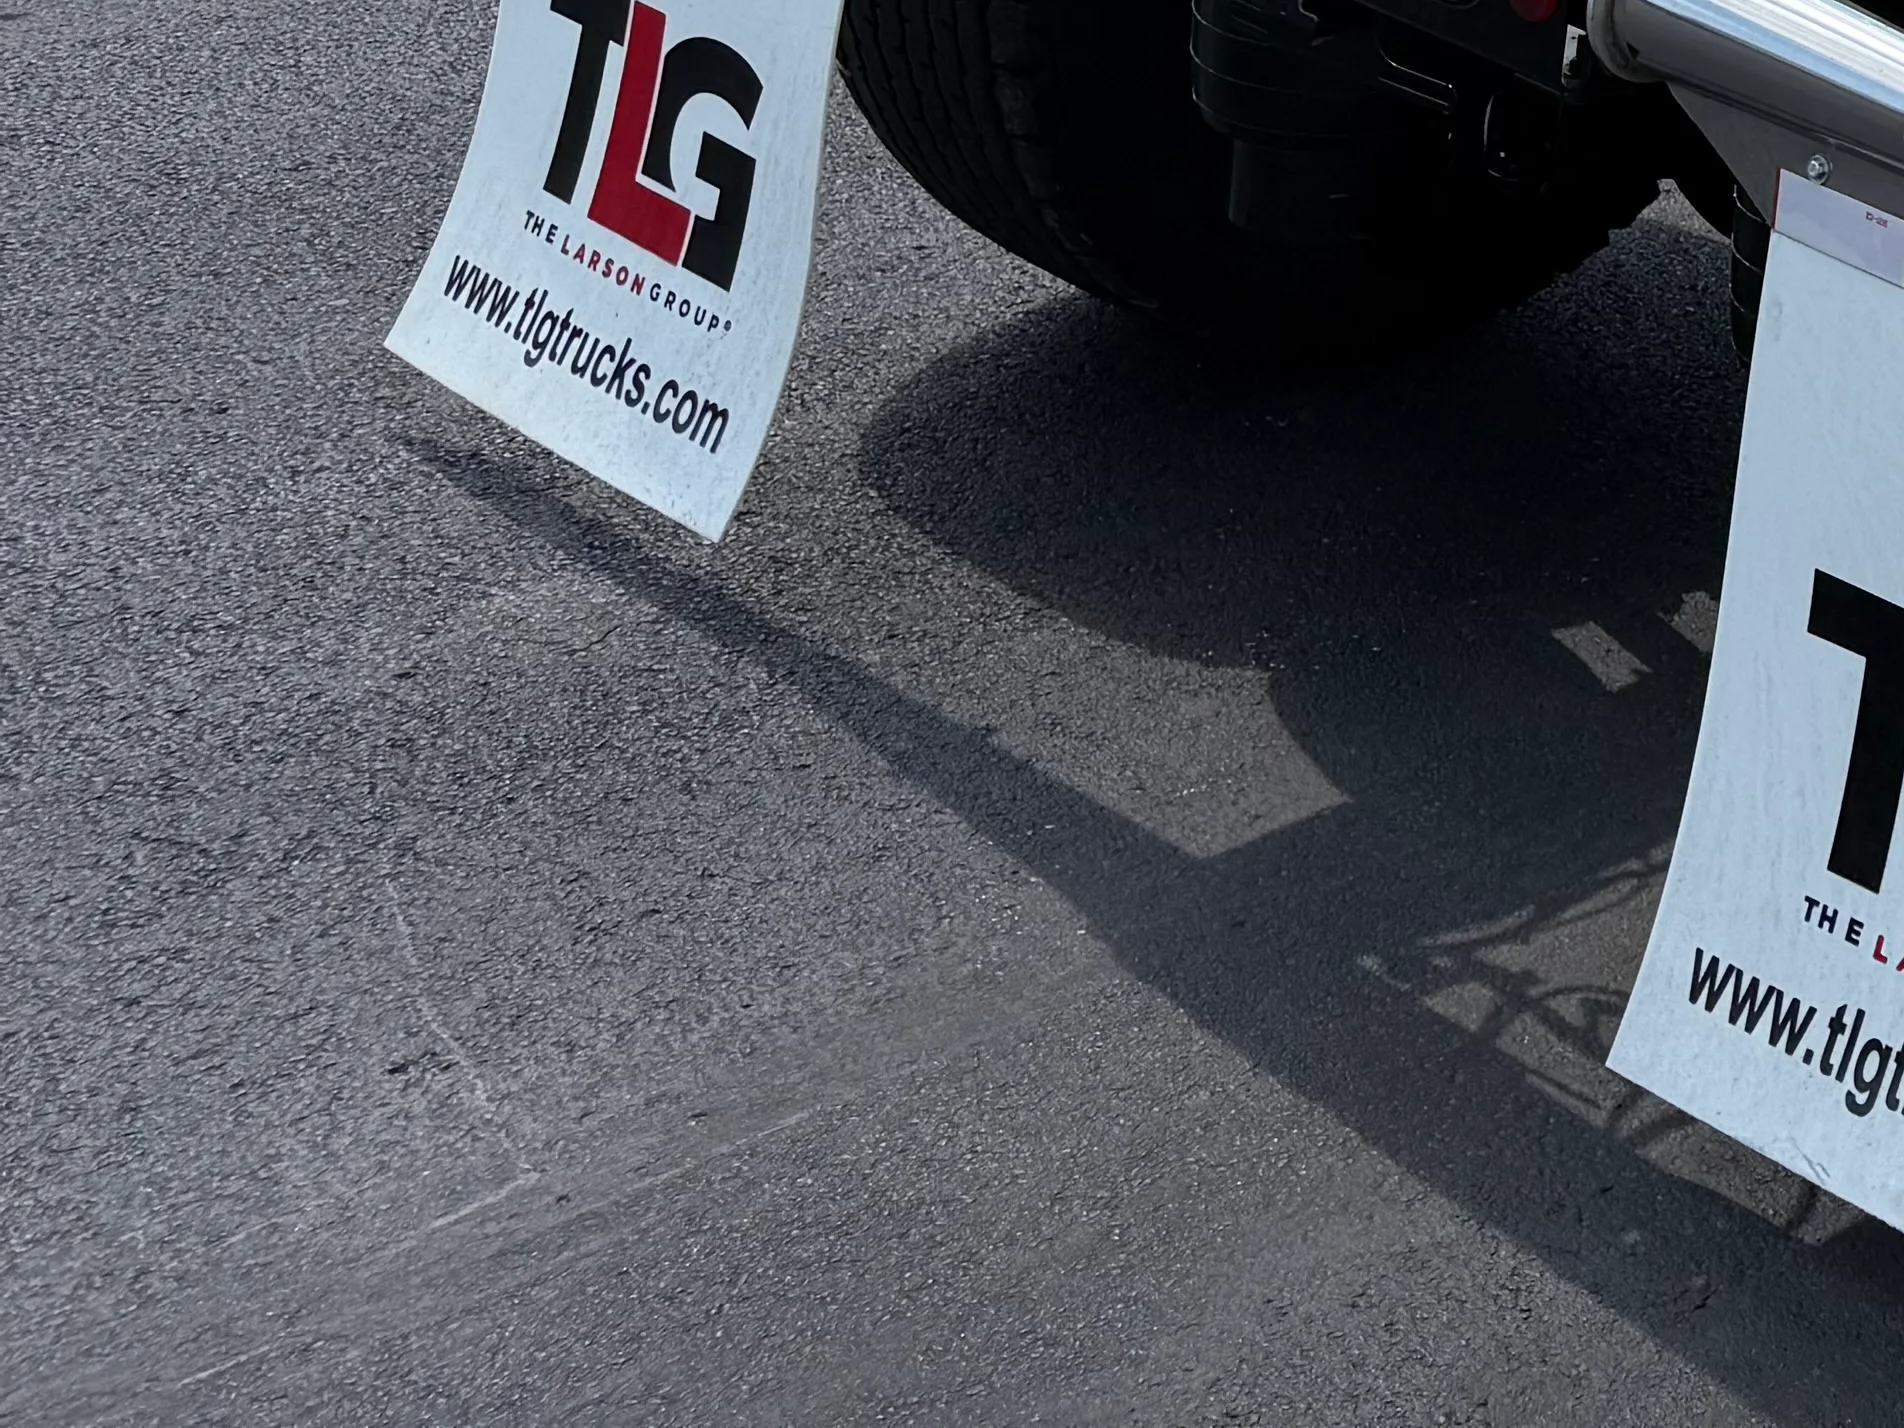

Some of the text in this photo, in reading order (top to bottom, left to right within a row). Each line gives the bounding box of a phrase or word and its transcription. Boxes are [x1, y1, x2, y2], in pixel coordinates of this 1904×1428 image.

[524, 210, 559, 244] THE
[560, 234, 646, 296] LARSON
[443, 253, 731, 454] www.tlgtrucks.com
[1804, 895, 1864, 946] THE
